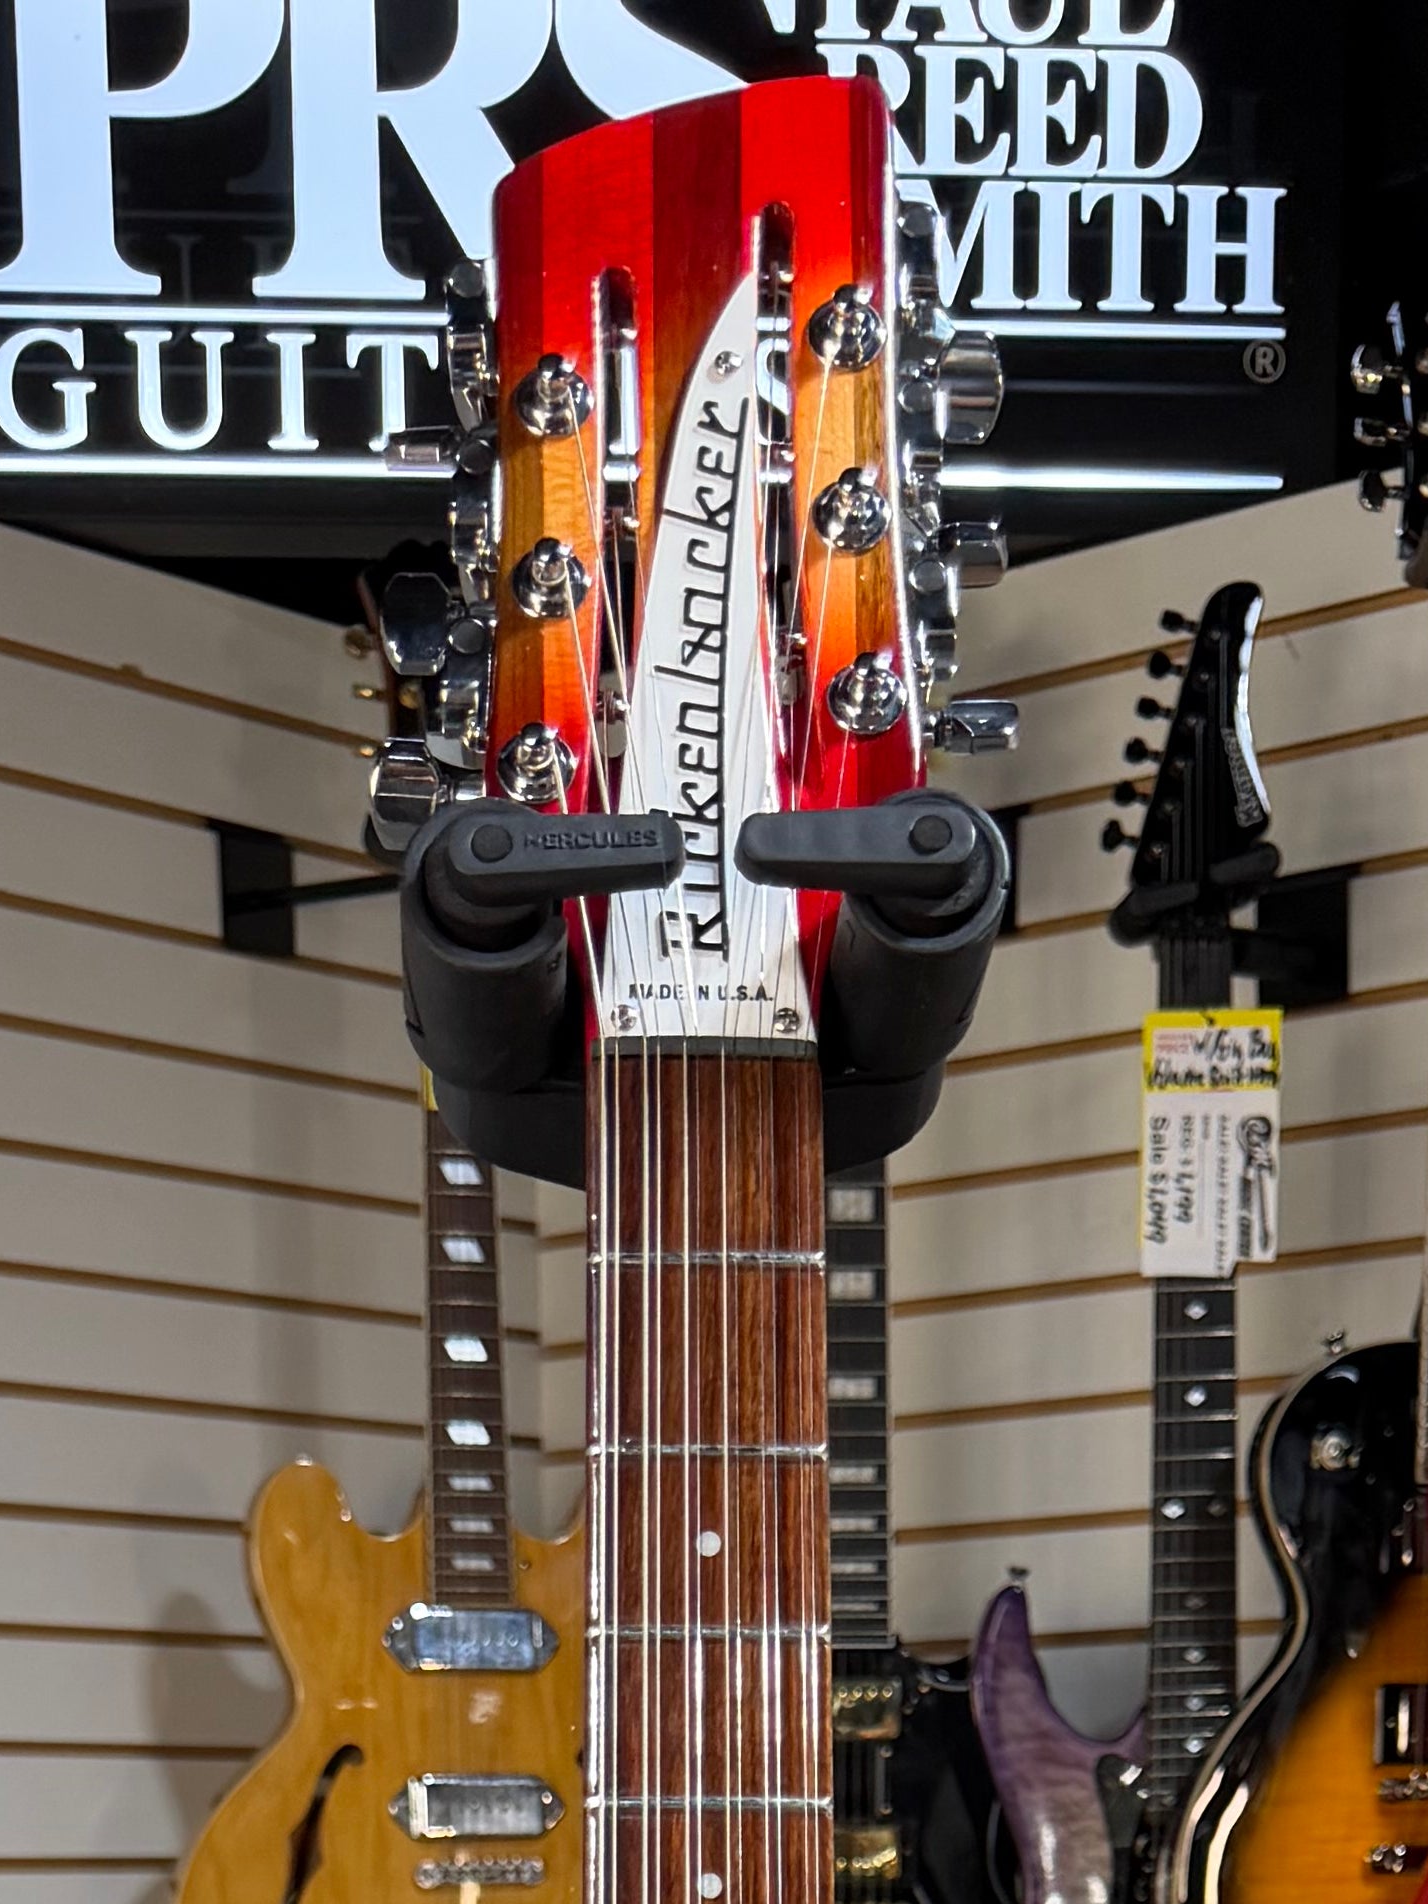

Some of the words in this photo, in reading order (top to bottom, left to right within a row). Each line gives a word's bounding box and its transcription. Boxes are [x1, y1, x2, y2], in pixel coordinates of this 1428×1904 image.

[894, 179, 1288, 313] MITH
[524, 829, 659, 851] HERCULES
[629, 983, 684, 1000] MADE
[1149, 1116, 1171, 1165] Sale
